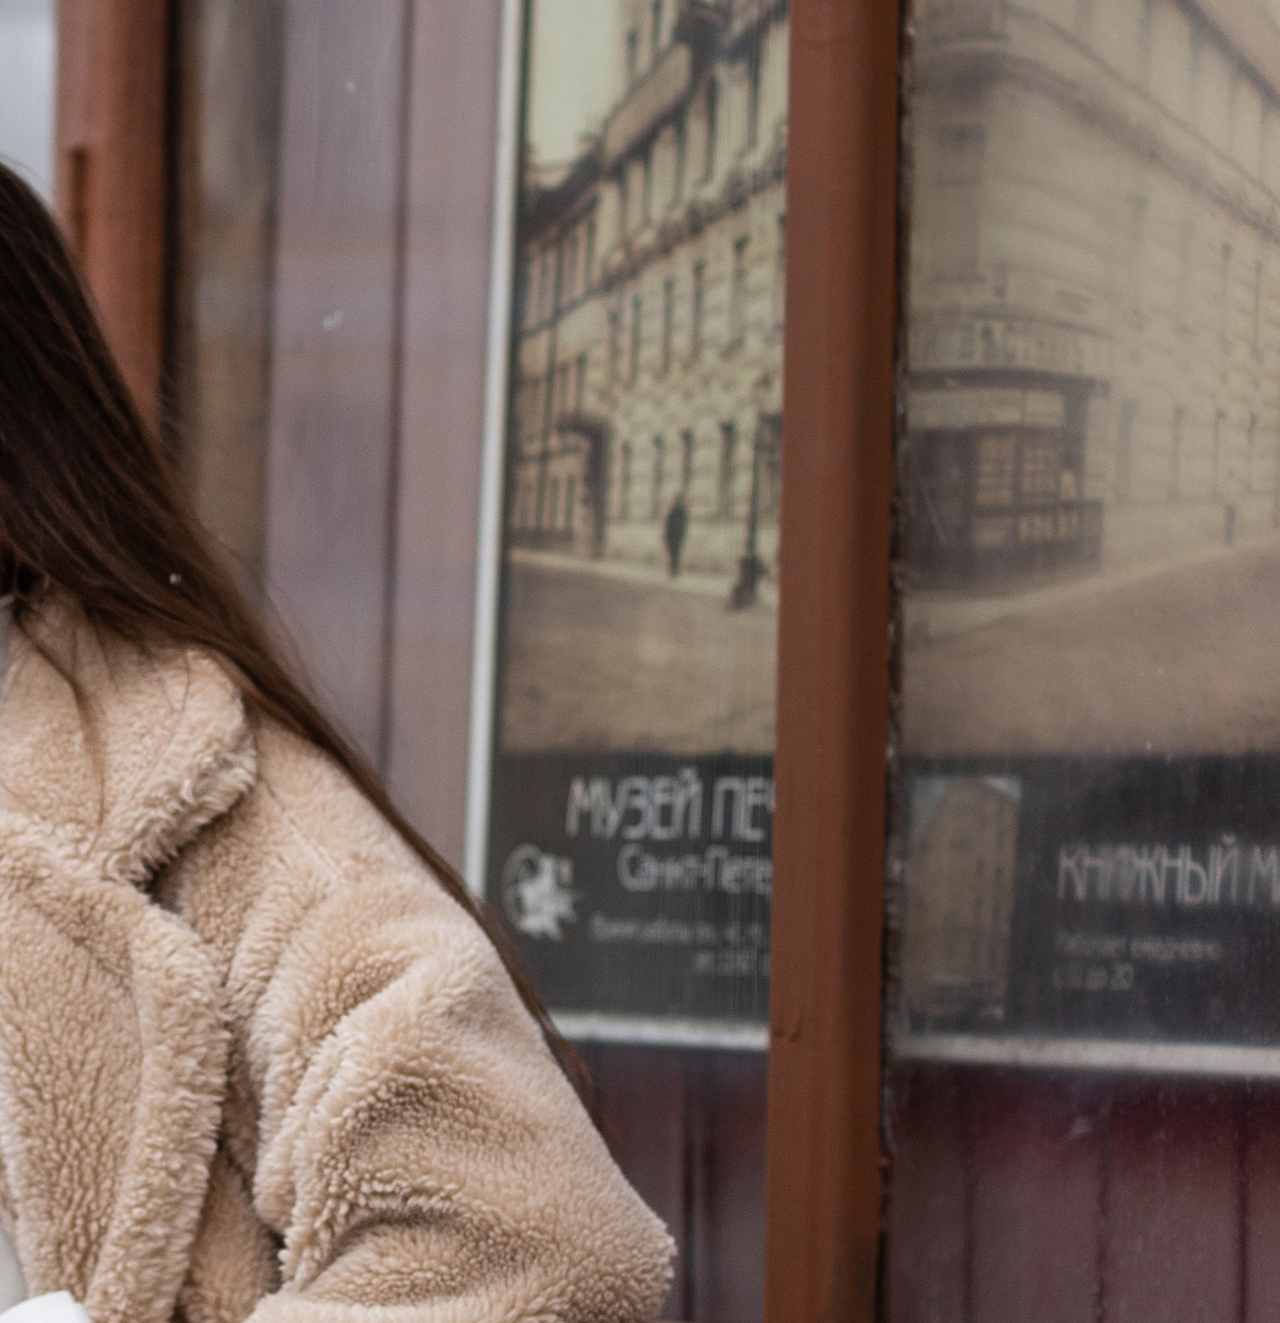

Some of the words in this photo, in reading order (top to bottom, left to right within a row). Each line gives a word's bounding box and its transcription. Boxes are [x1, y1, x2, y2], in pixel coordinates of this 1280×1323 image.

[566, 765, 703, 841] МУЗЕЙ
[711, 774, 776, 843] ПЕ
[1057, 832, 1240, 906] КНИЖНЫЙ
